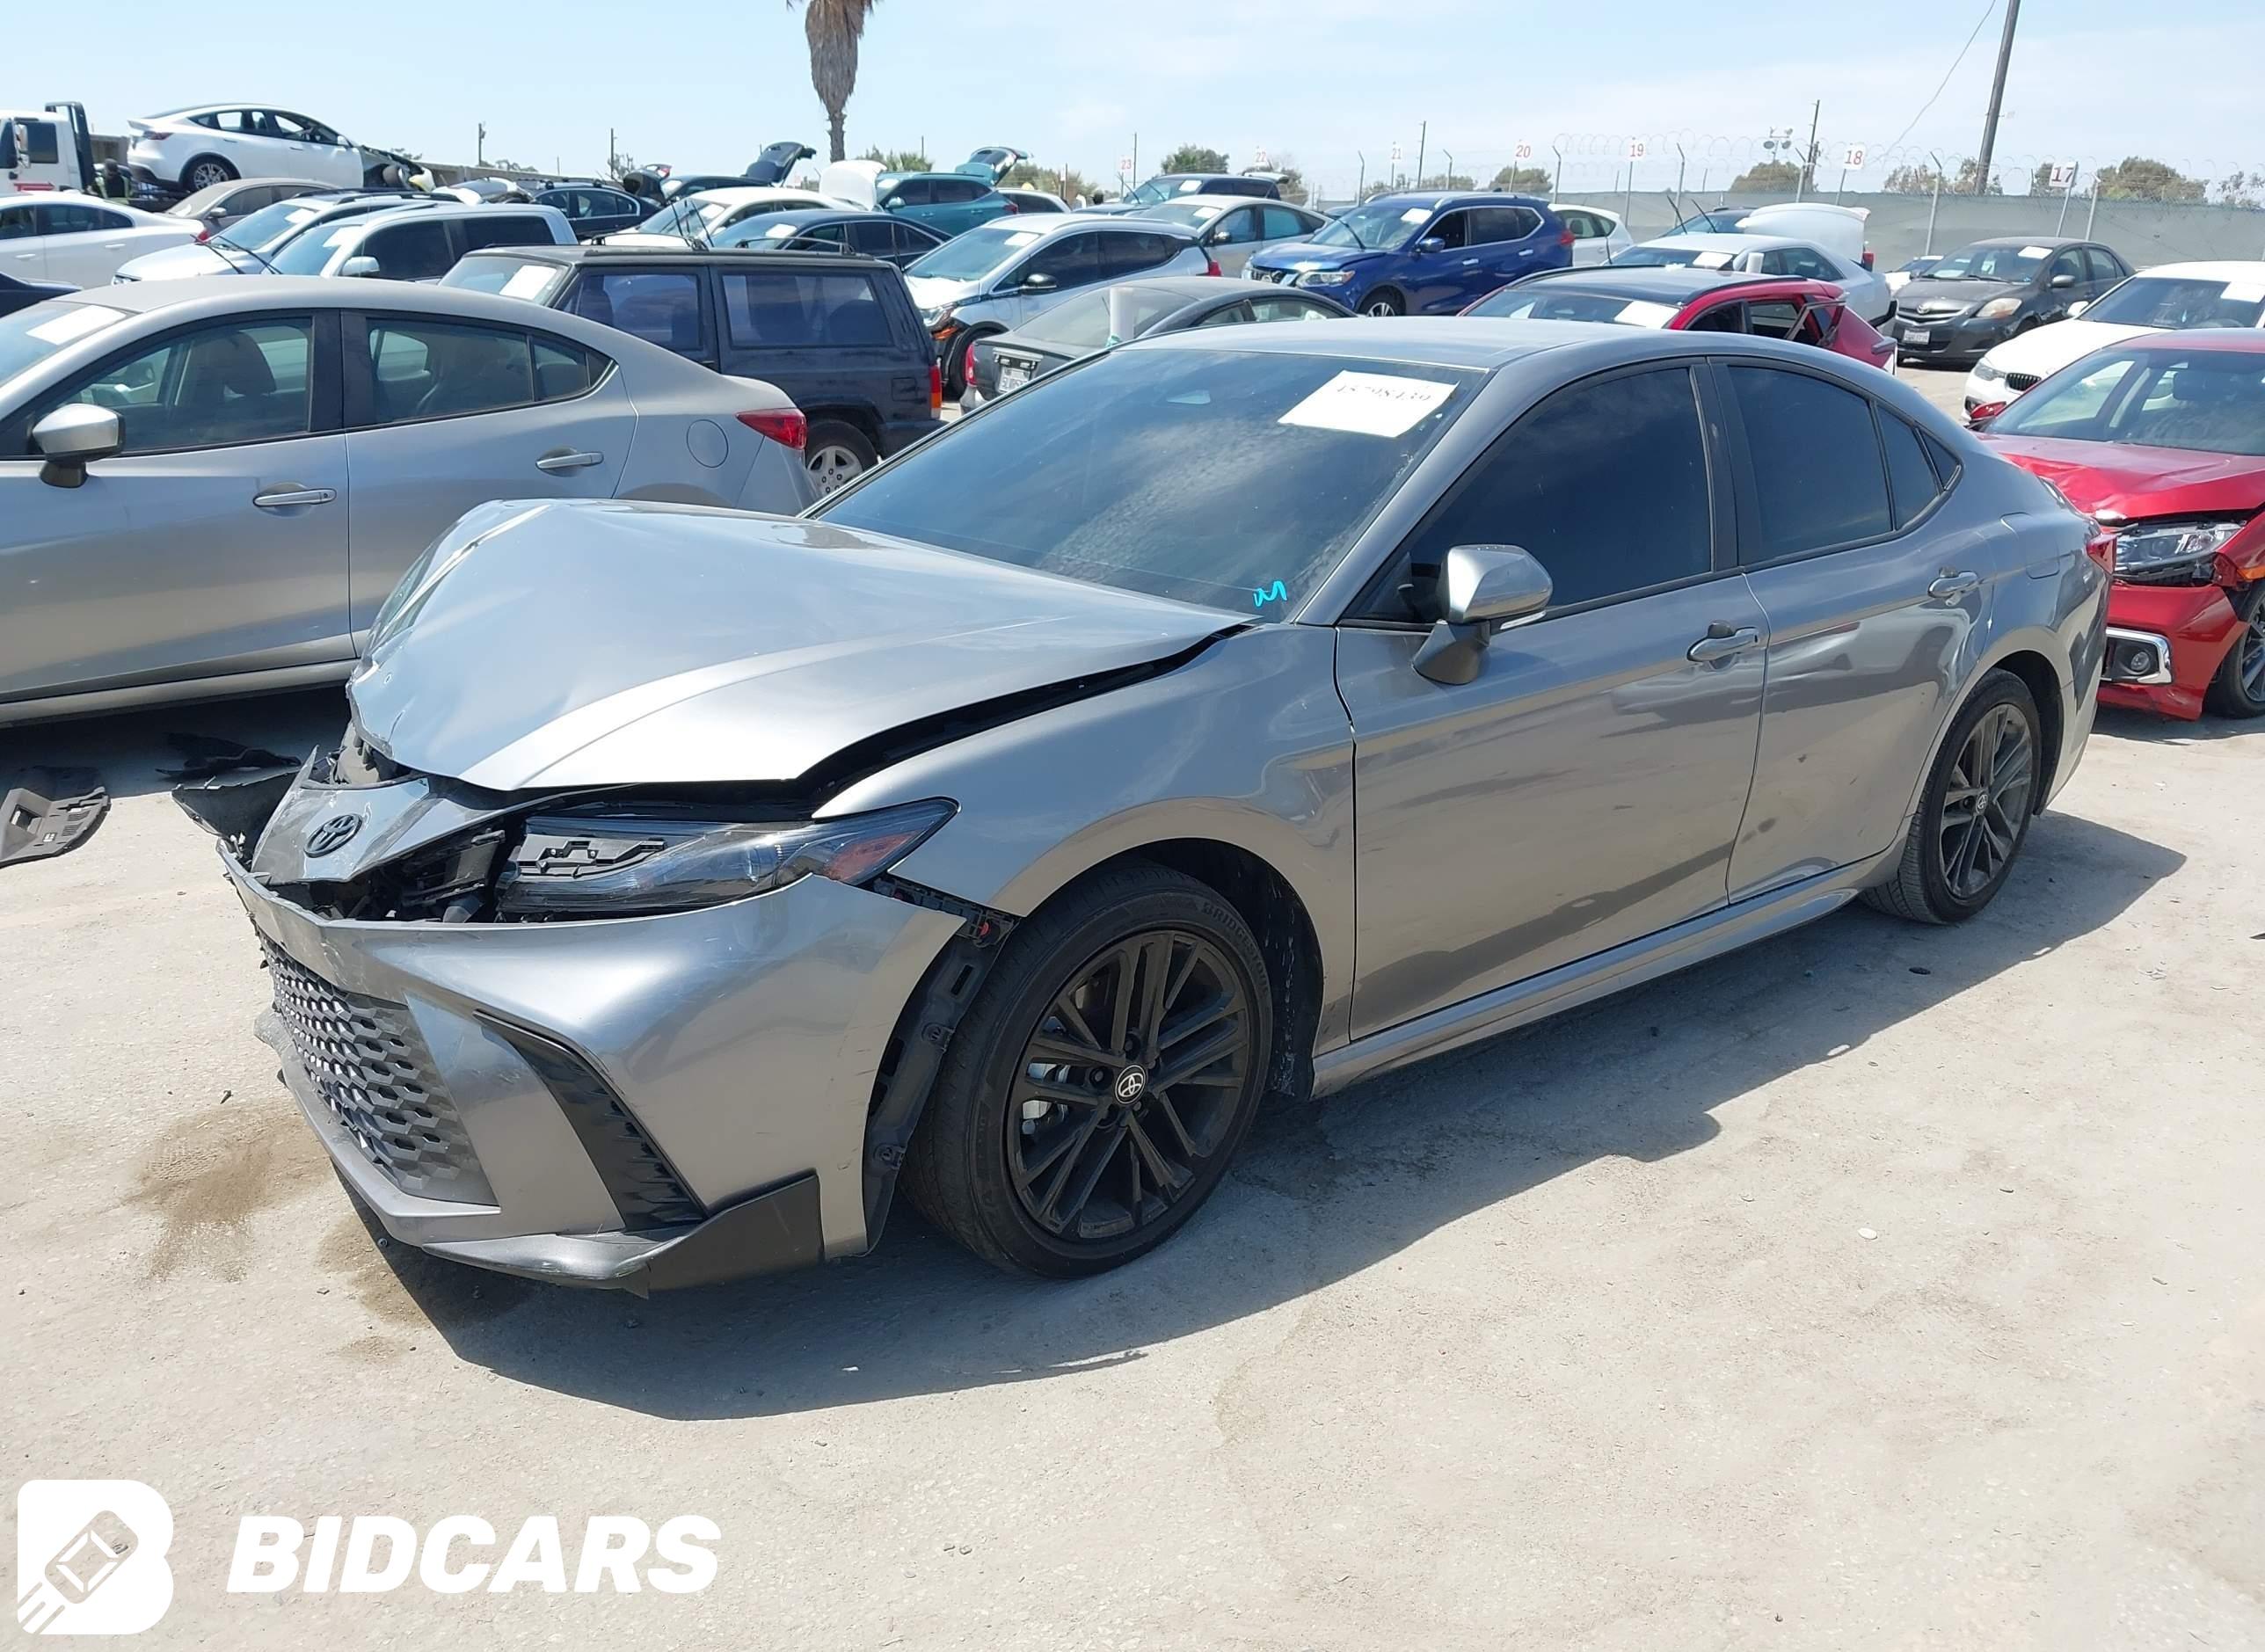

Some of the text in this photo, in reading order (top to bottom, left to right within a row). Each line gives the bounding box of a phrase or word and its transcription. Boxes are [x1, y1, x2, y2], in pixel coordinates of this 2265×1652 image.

[1391, 147, 1402, 160] 21
[1515, 144, 1531, 158] 20
[1630, 142, 1644, 157] 19
[1256, 151, 1266, 163] 22
[1844, 149, 1863, 165] 18
[1121, 159, 1132, 170] 23
[2051, 166, 2074, 183] 17
